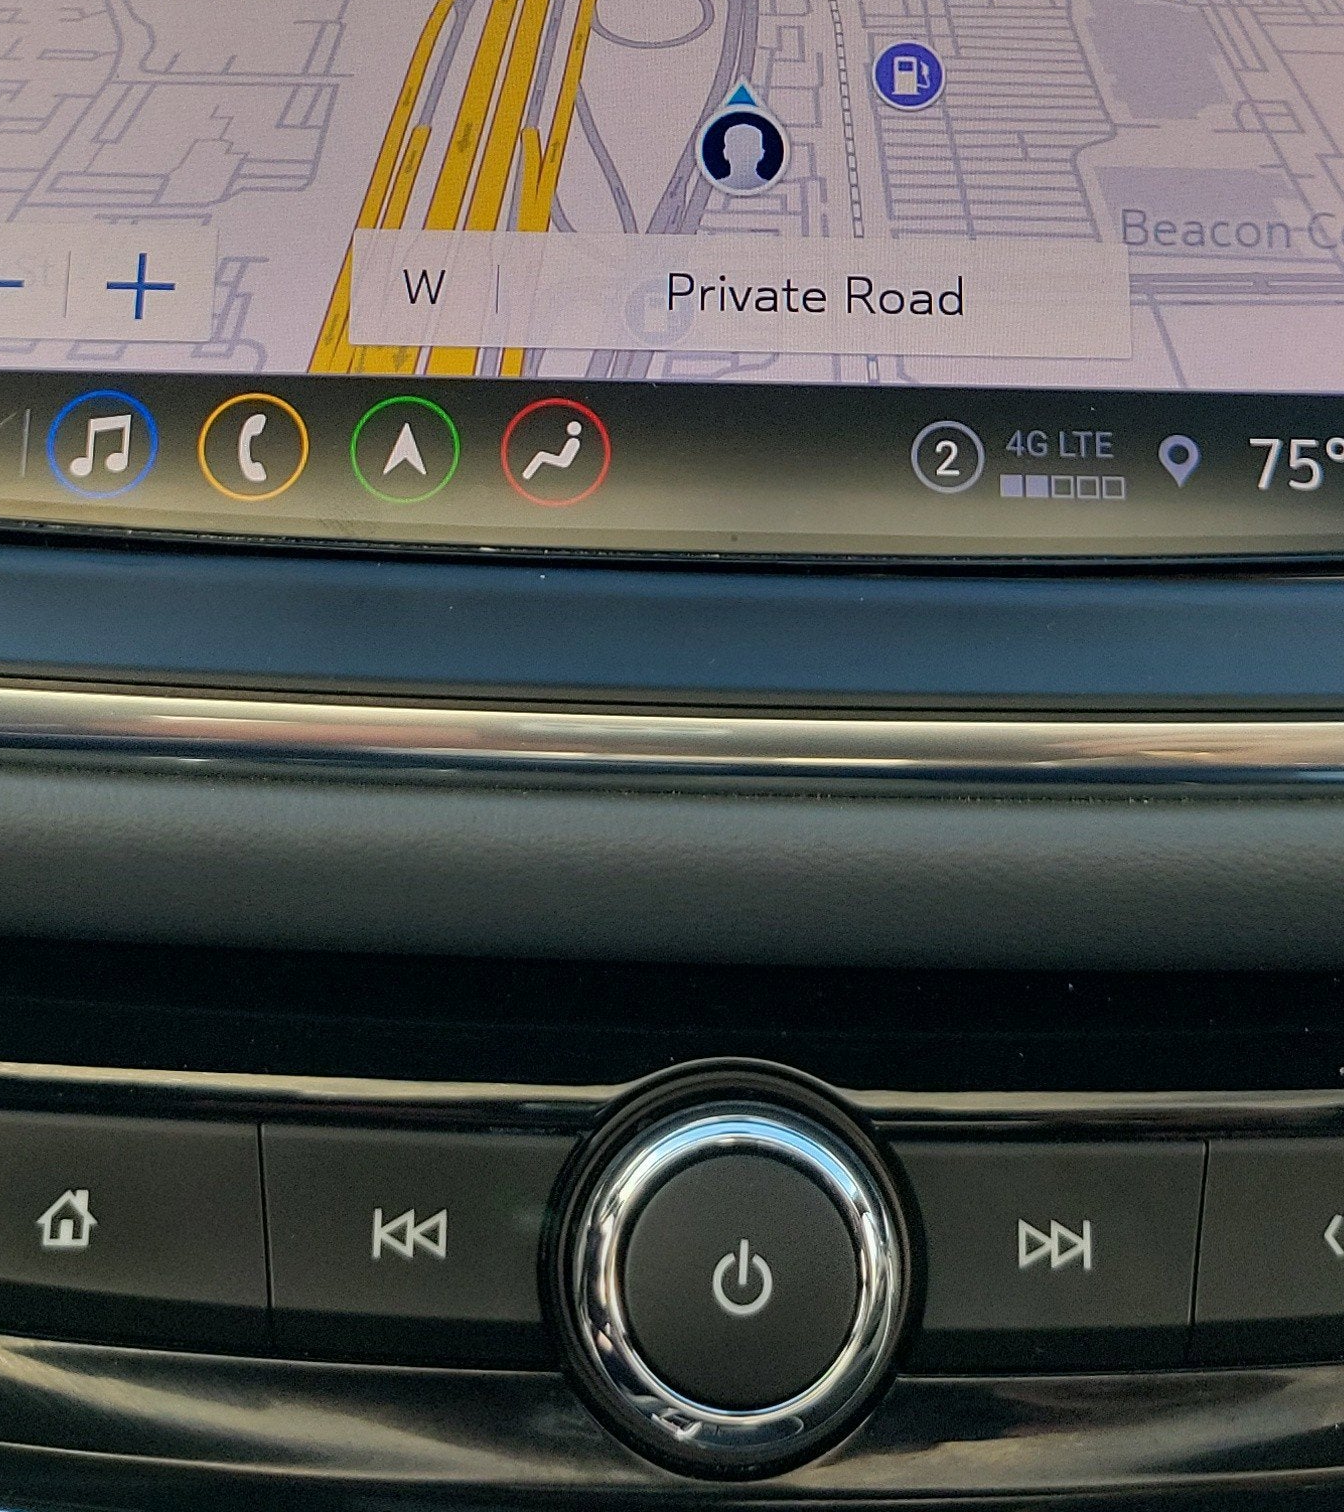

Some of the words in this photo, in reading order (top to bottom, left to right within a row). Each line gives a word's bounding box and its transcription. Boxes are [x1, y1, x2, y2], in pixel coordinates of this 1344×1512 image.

[1121, 209, 1291, 249] Beacon
[403, 268, 447, 306] W
[667, 272, 827, 314] Private
[845, 276, 965, 317] Road
[934, 440, 961, 477] 2
[1005, 429, 1049, 458] 4G
[1059, 430, 1115, 459] LTE
